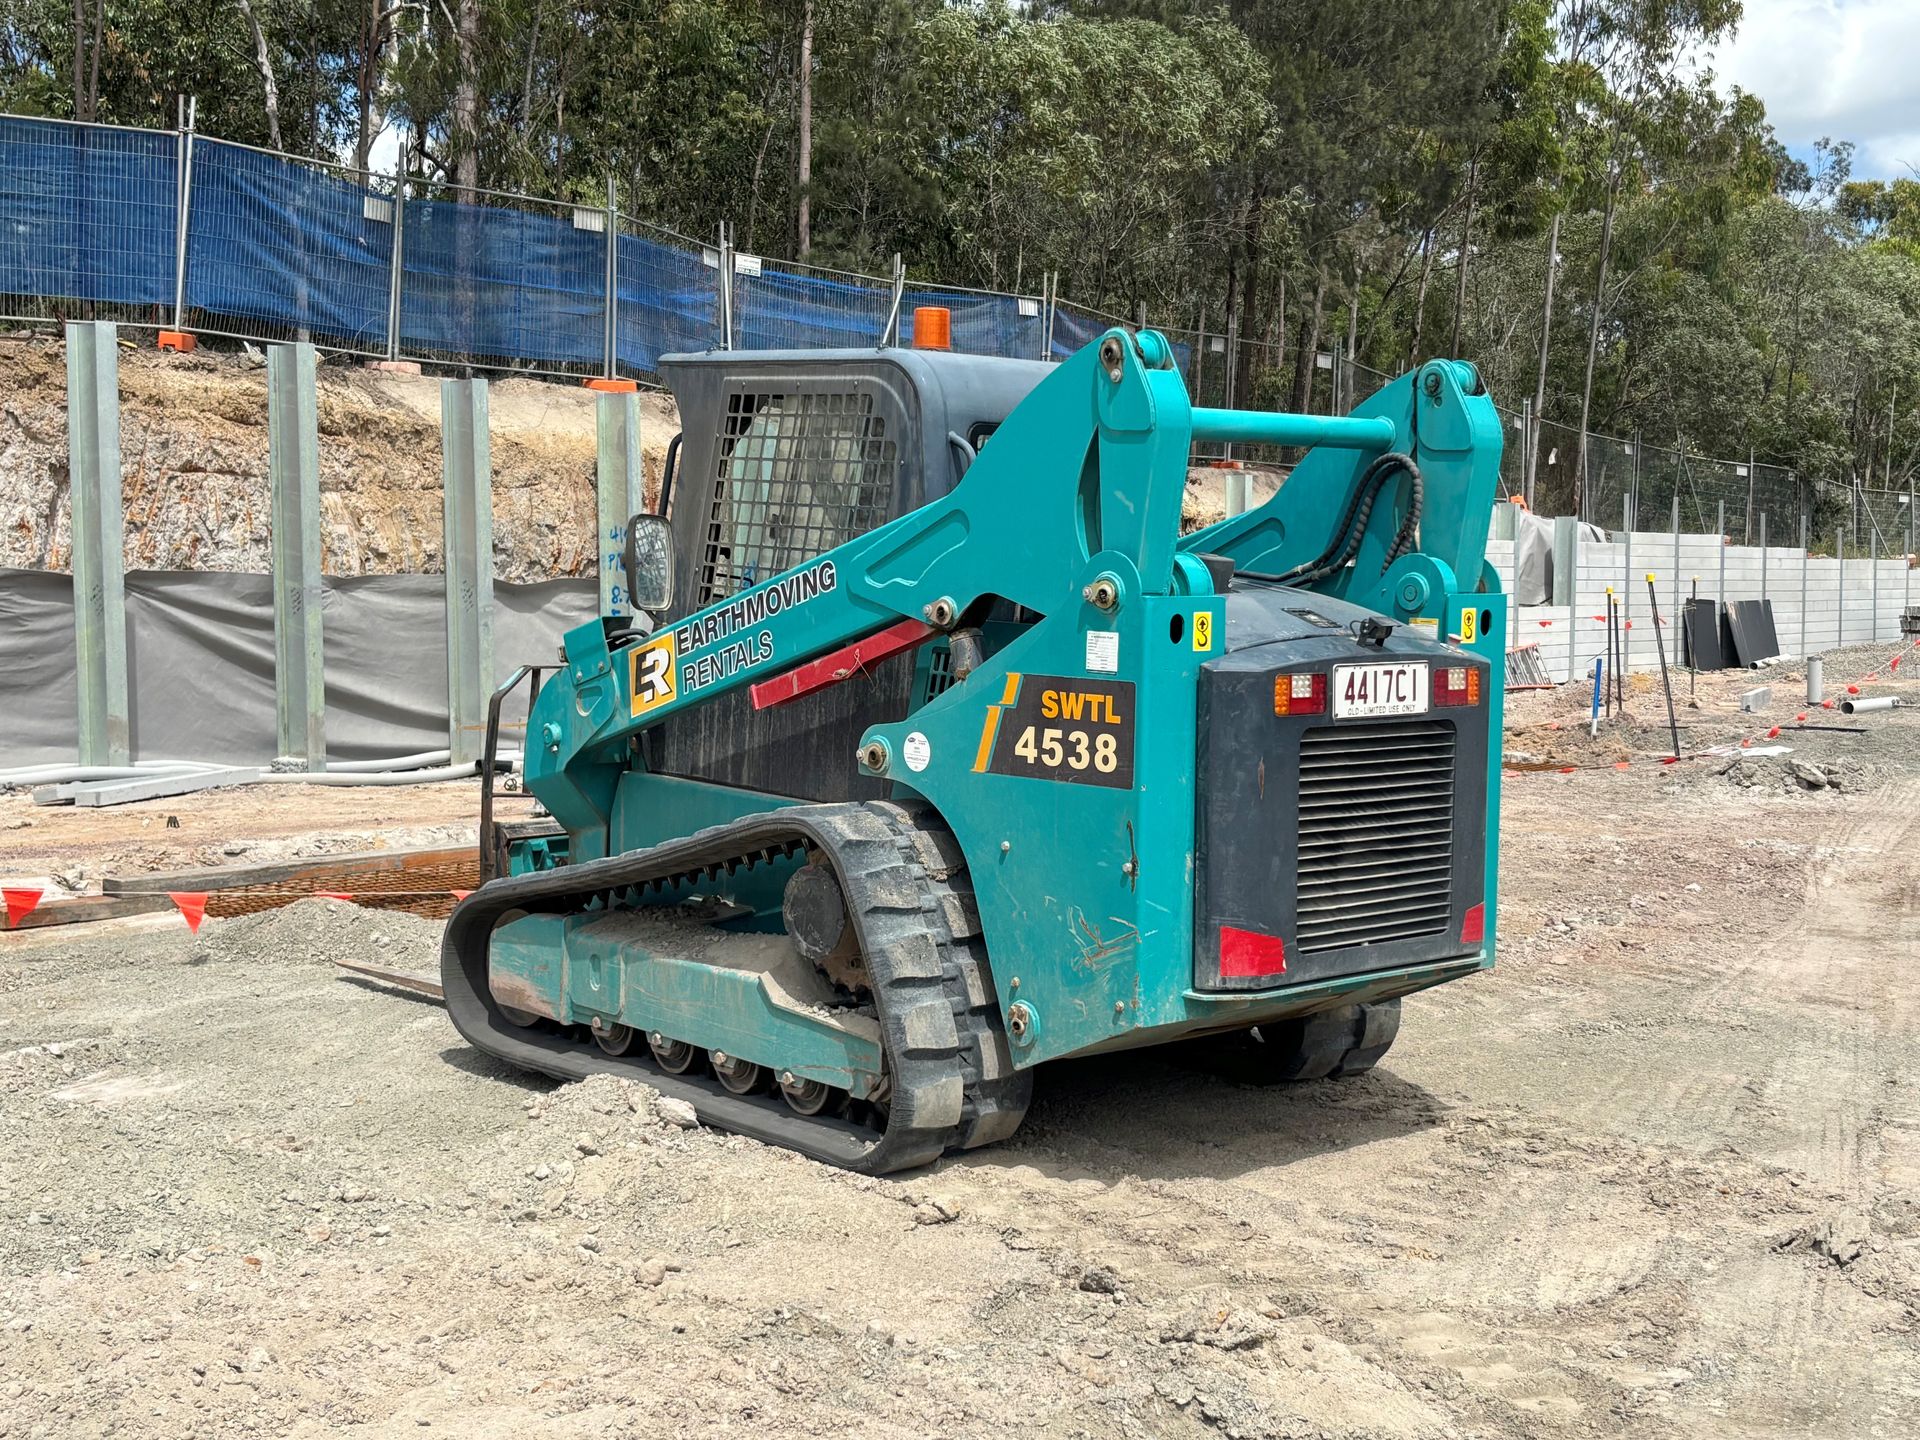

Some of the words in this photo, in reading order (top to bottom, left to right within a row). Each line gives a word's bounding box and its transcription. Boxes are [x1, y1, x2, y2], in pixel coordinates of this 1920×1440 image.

[676, 560, 837, 657] EARTHMOVING
[634, 646, 673, 704] ER
[682, 631, 774, 696] RENTALS
[1041, 689, 1121, 725] SWTL
[1014, 726, 1118, 773] 4538
